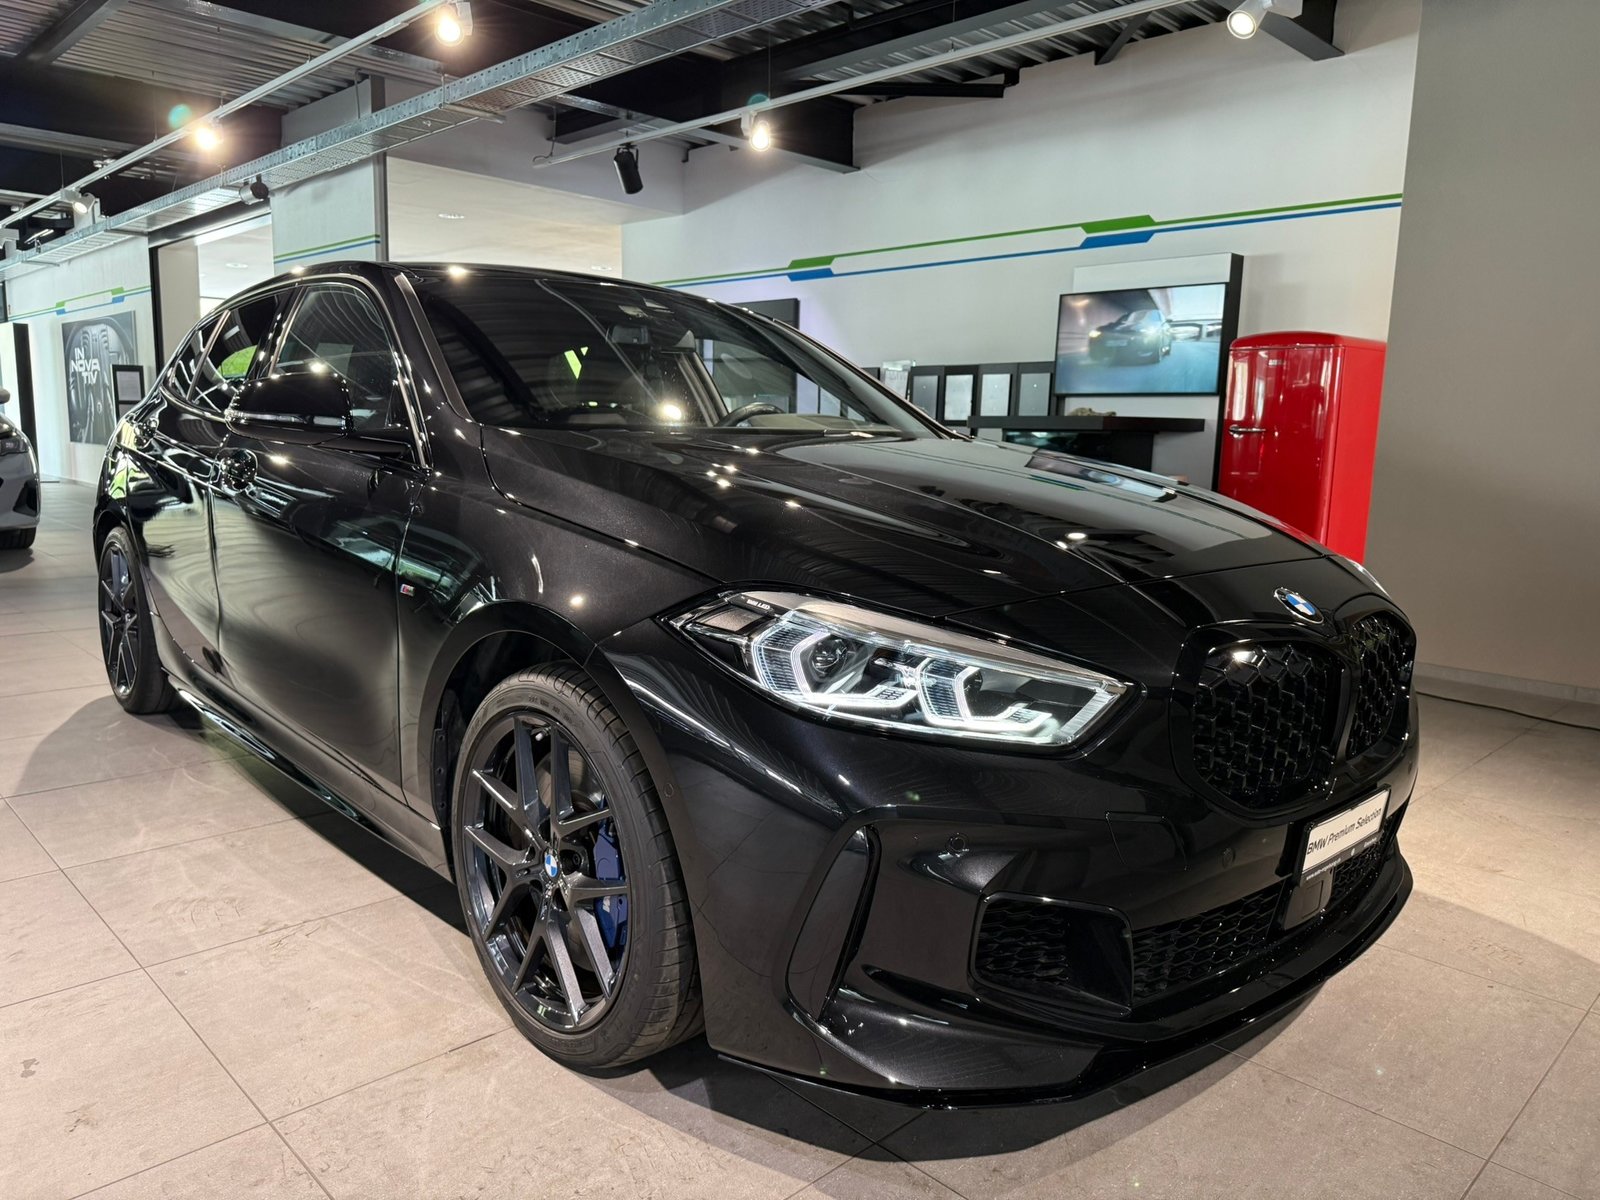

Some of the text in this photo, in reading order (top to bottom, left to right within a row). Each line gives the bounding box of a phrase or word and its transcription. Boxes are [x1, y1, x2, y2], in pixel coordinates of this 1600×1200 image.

[74, 347, 85, 360] IN
[71, 358, 100, 372] NOVA
[82, 370, 98, 385] TIV
[1306, 834, 1329, 855] BMW
[1327, 823, 1356, 845] Premium
[1355, 807, 1382, 830] Selection
